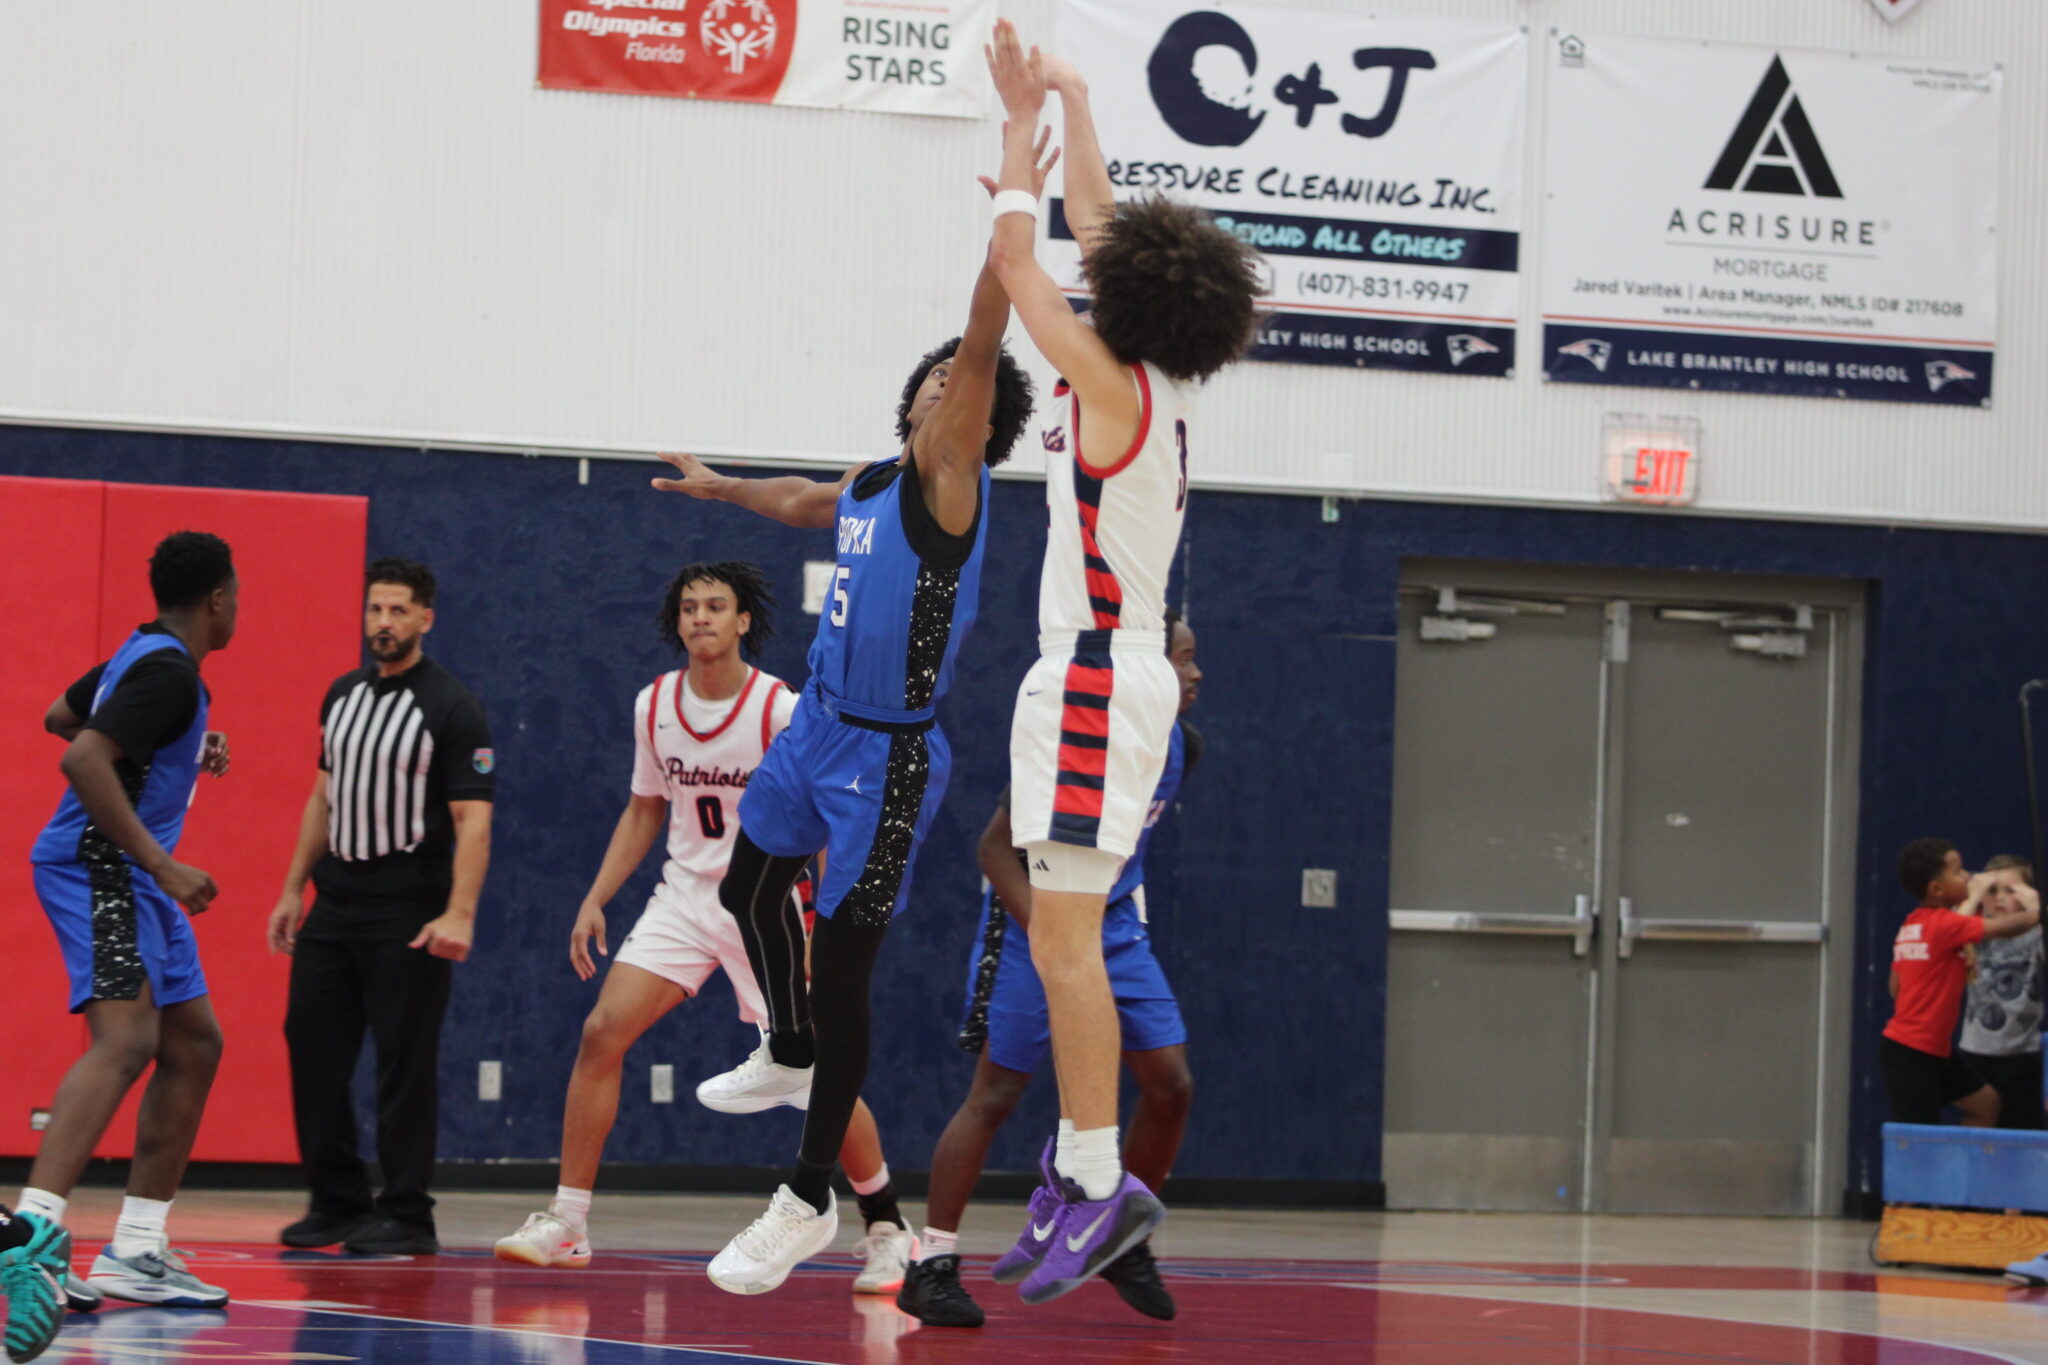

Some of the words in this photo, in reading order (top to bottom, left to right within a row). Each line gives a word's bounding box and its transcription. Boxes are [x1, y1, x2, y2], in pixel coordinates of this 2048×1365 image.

[562, 10, 686, 38] Olympics
[843, 17, 950, 50] RISING
[624, 42, 685, 63] Florida
[846, 54, 946, 86] STARS
[1107, 160, 1244, 194] RESSURE
[1257, 167, 1422, 207] CLEANING
[1429, 178, 1496, 213] INC.
[1312, 225, 1364, 254] ALL
[1371, 228, 1466, 261] OTHERS
[1667, 208, 1875, 246] ACRISURE
[1713, 257, 1828, 282] MORTGAGE
[1297, 271, 1470, 303] (407)-831-9947
[1573, 278, 1619, 294] Jared
[1624, 281, 1682, 299] Varitek
[1700, 285, 1736, 302] Area
[1743, 289, 1817, 309] Manager,
[1821, 293, 1866, 311] NMLS
[1906, 300, 1963, 318] 217608
[1300, 333, 1347, 350] HIGH
[1353, 337, 1430, 357] SCHOOL
[1627, 350, 1676, 369] LAKE
[1682, 354, 1777, 374] BRANTLEY
[1784, 360, 1830, 378] HIGH
[1836, 363, 1910, 383] SCHOOL
[1633, 447, 1692, 496] EXIT
[830, 567, 850, 627] 5
[665, 757, 752, 788] Patriots
[696, 796, 725, 839] 0
